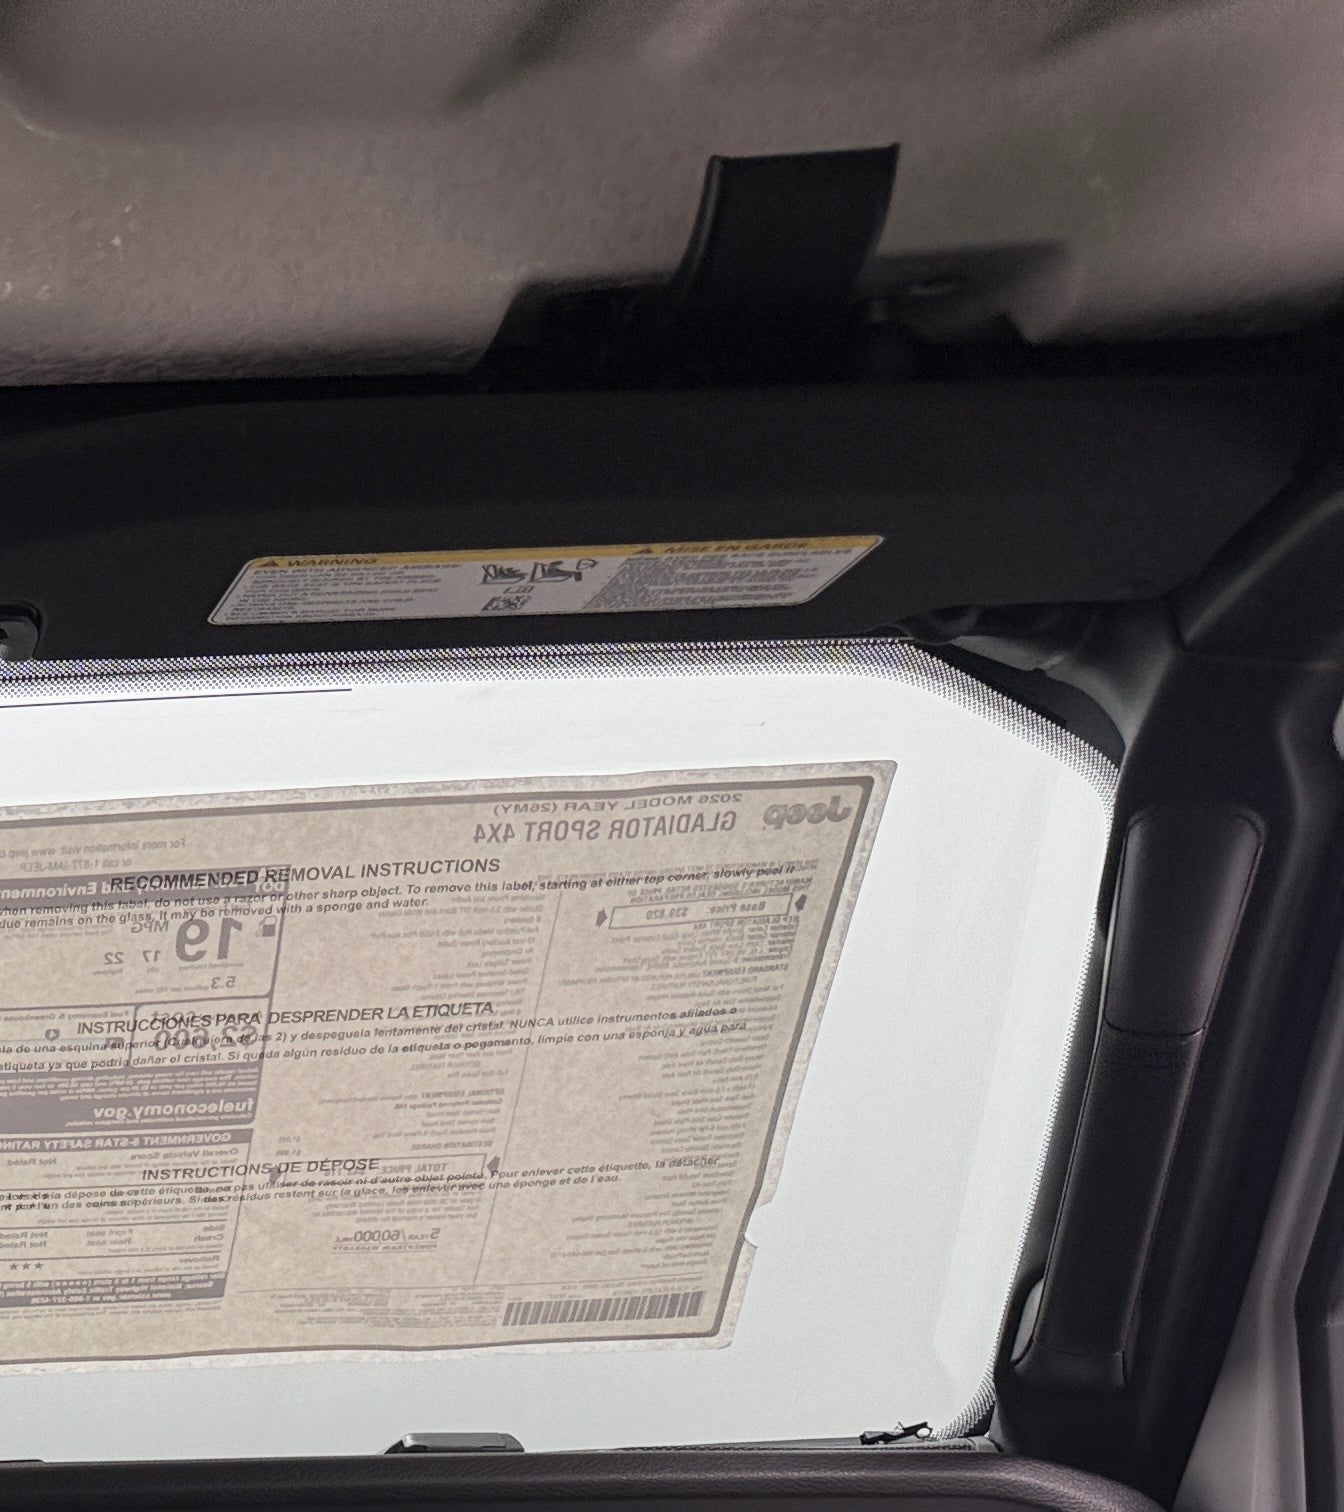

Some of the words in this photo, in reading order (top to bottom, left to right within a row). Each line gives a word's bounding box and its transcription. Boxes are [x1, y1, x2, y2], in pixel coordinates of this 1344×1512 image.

[287, 557, 378, 567] WARNING
[111, 870, 260, 891] RECOMMENDED
[264, 865, 356, 884] REMOVAL
[361, 858, 501, 879] INSTRUCTIONS
[30, 903, 88, 917] removing
[92, 901, 114, 912] this
[154, 897, 171, 908] do
[174, 896, 195, 906] not
[322, 889, 358, 901] sharp
[361, 886, 401, 899] object.
[408, 884, 421, 894] To
[424, 883, 472, 894] remove
[475, 881, 498, 892] this
[502, 879, 536, 892] label,
[787, 865, 796, 875] it
[24, 915, 74, 928] remains
[77, 915, 93, 925] on
[96, 913, 116, 924] the
[119, 910, 155, 925] glass,
[160, 909, 169, 919] it
[171, 908, 197, 921] may
[200, 907, 215, 918] be
[218, 906, 273, 917] removed
[276, 903, 302, 914] with
[305, 904, 313, 913] a
[316, 901, 362, 915] sponge
[366, 899, 389, 910] and
[392, 897, 429, 908] water.
[77, 1014, 211, 1035] INSTRUCCIONES
[215, 1012, 260, 1026] PARA
[268, 1008, 384, 1025] DESPRENDER
[388, 1006, 410, 1019] LA
[412, 1001, 493, 1018] ETIQUETA
[142, 1162, 270, 1181] INSTRUCTIONS
[277, 1161, 302, 1173] DE
[306, 1156, 380, 1173] DÉPOSE
